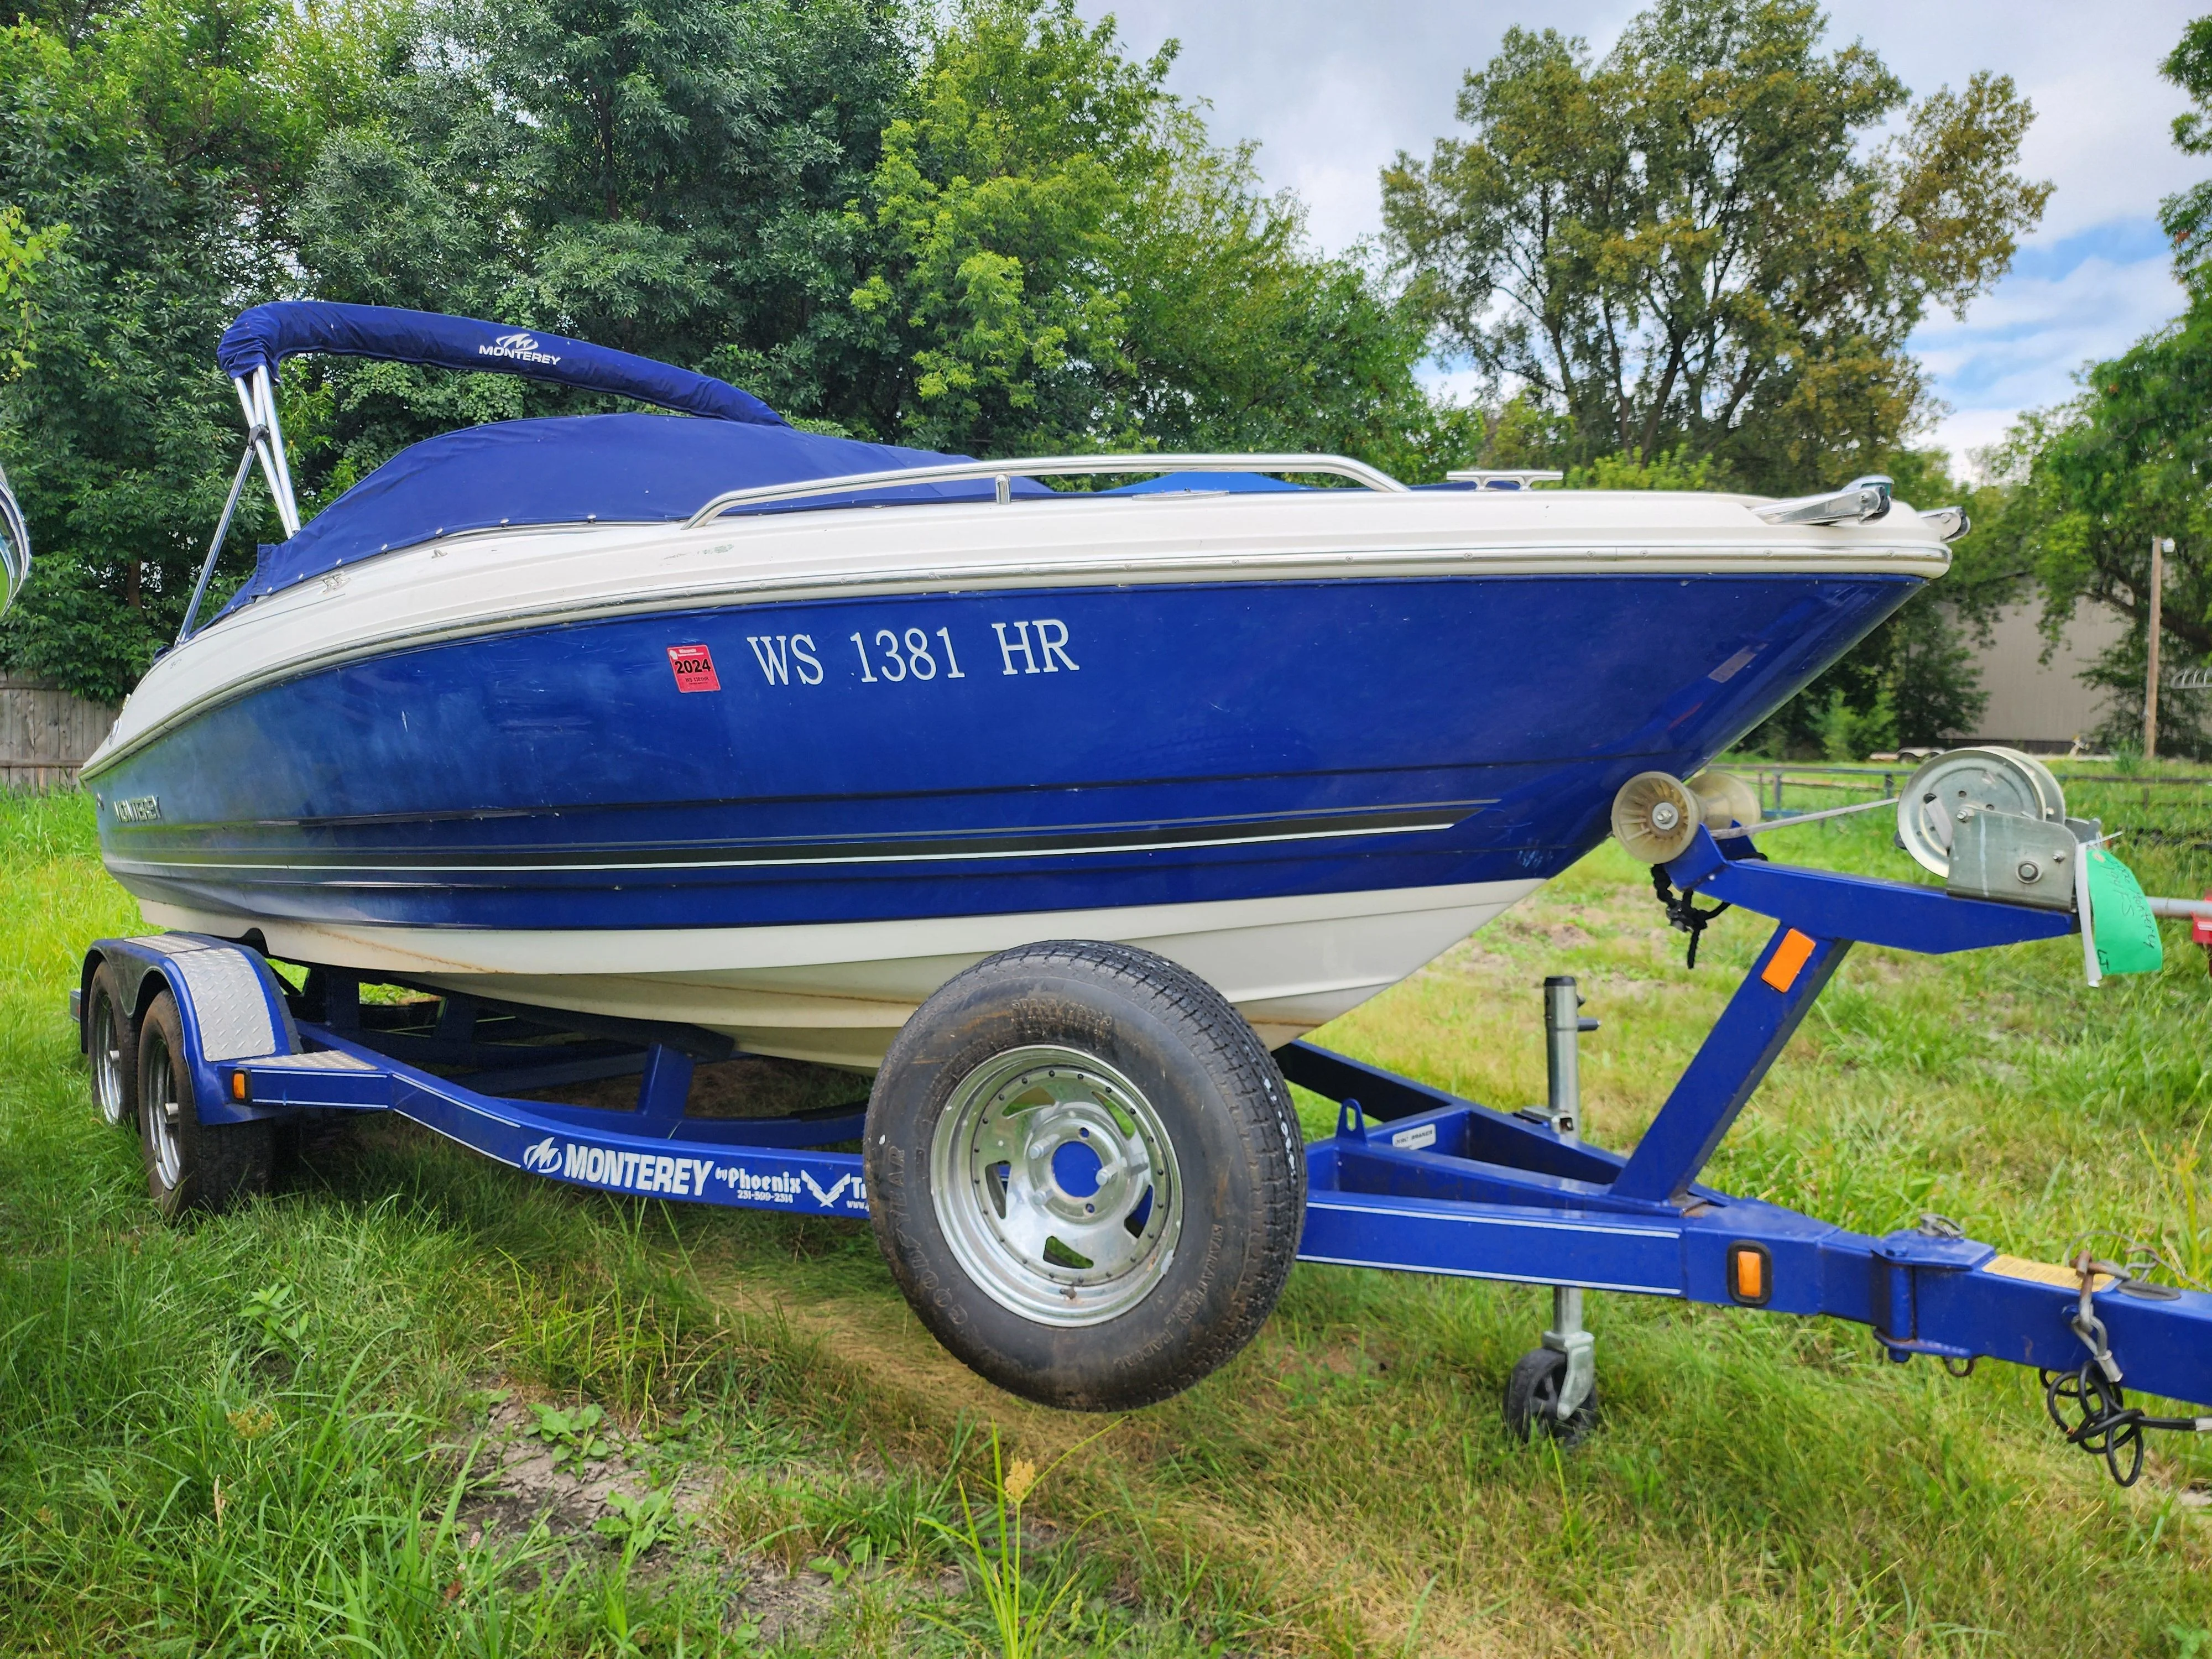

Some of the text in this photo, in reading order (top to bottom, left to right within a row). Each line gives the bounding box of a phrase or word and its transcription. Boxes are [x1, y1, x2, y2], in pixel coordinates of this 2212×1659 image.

[479, 345, 561, 365] MONTEREY
[747, 619, 1081, 685] WS 1381 HR
[675, 659, 711, 674] 2024
[564, 1144, 714, 1196] MONTEREY
[715, 1167, 728, 1181] by
[728, 1167, 801, 1194] Phoenix
